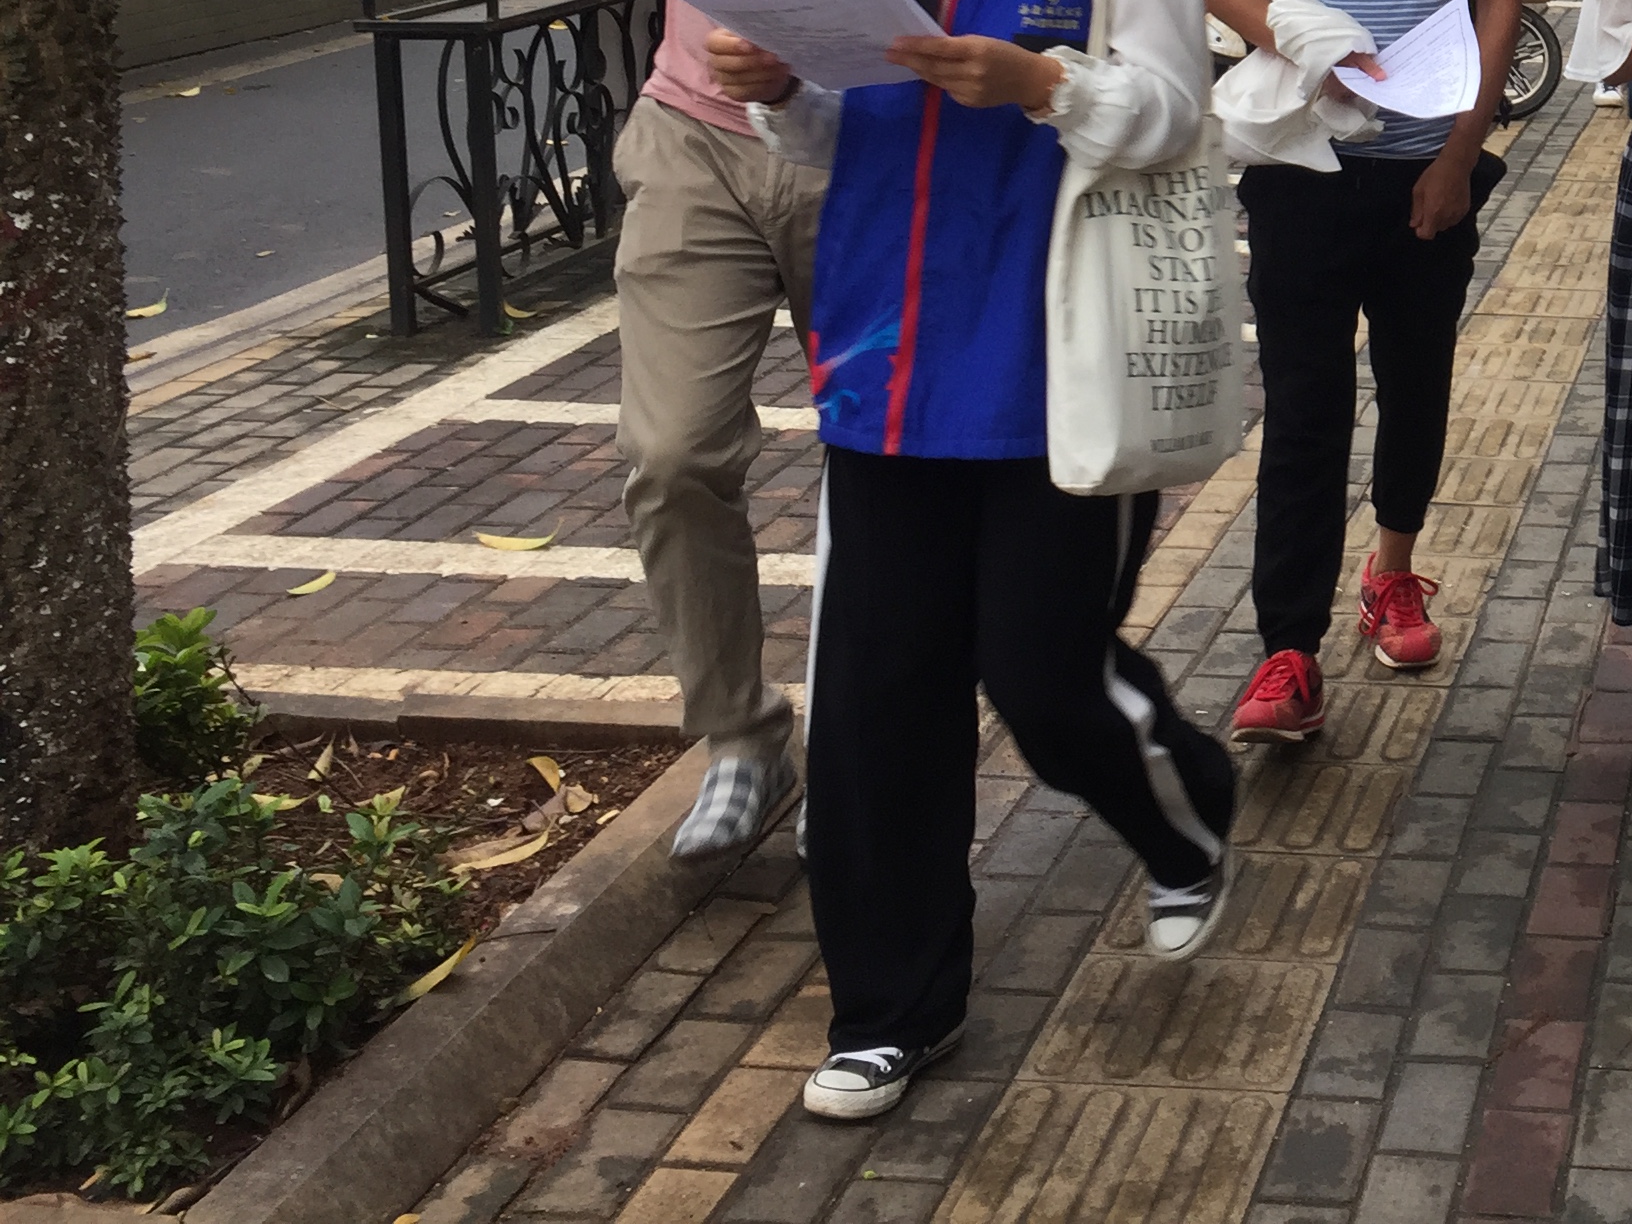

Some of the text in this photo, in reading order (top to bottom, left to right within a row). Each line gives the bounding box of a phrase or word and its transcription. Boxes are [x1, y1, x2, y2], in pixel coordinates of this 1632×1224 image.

[1140, 166, 1210, 197] THE
[1130, 222, 1157, 249] IS
[1134, 287, 1166, 313] IT
[1171, 288, 1199, 314] IS
